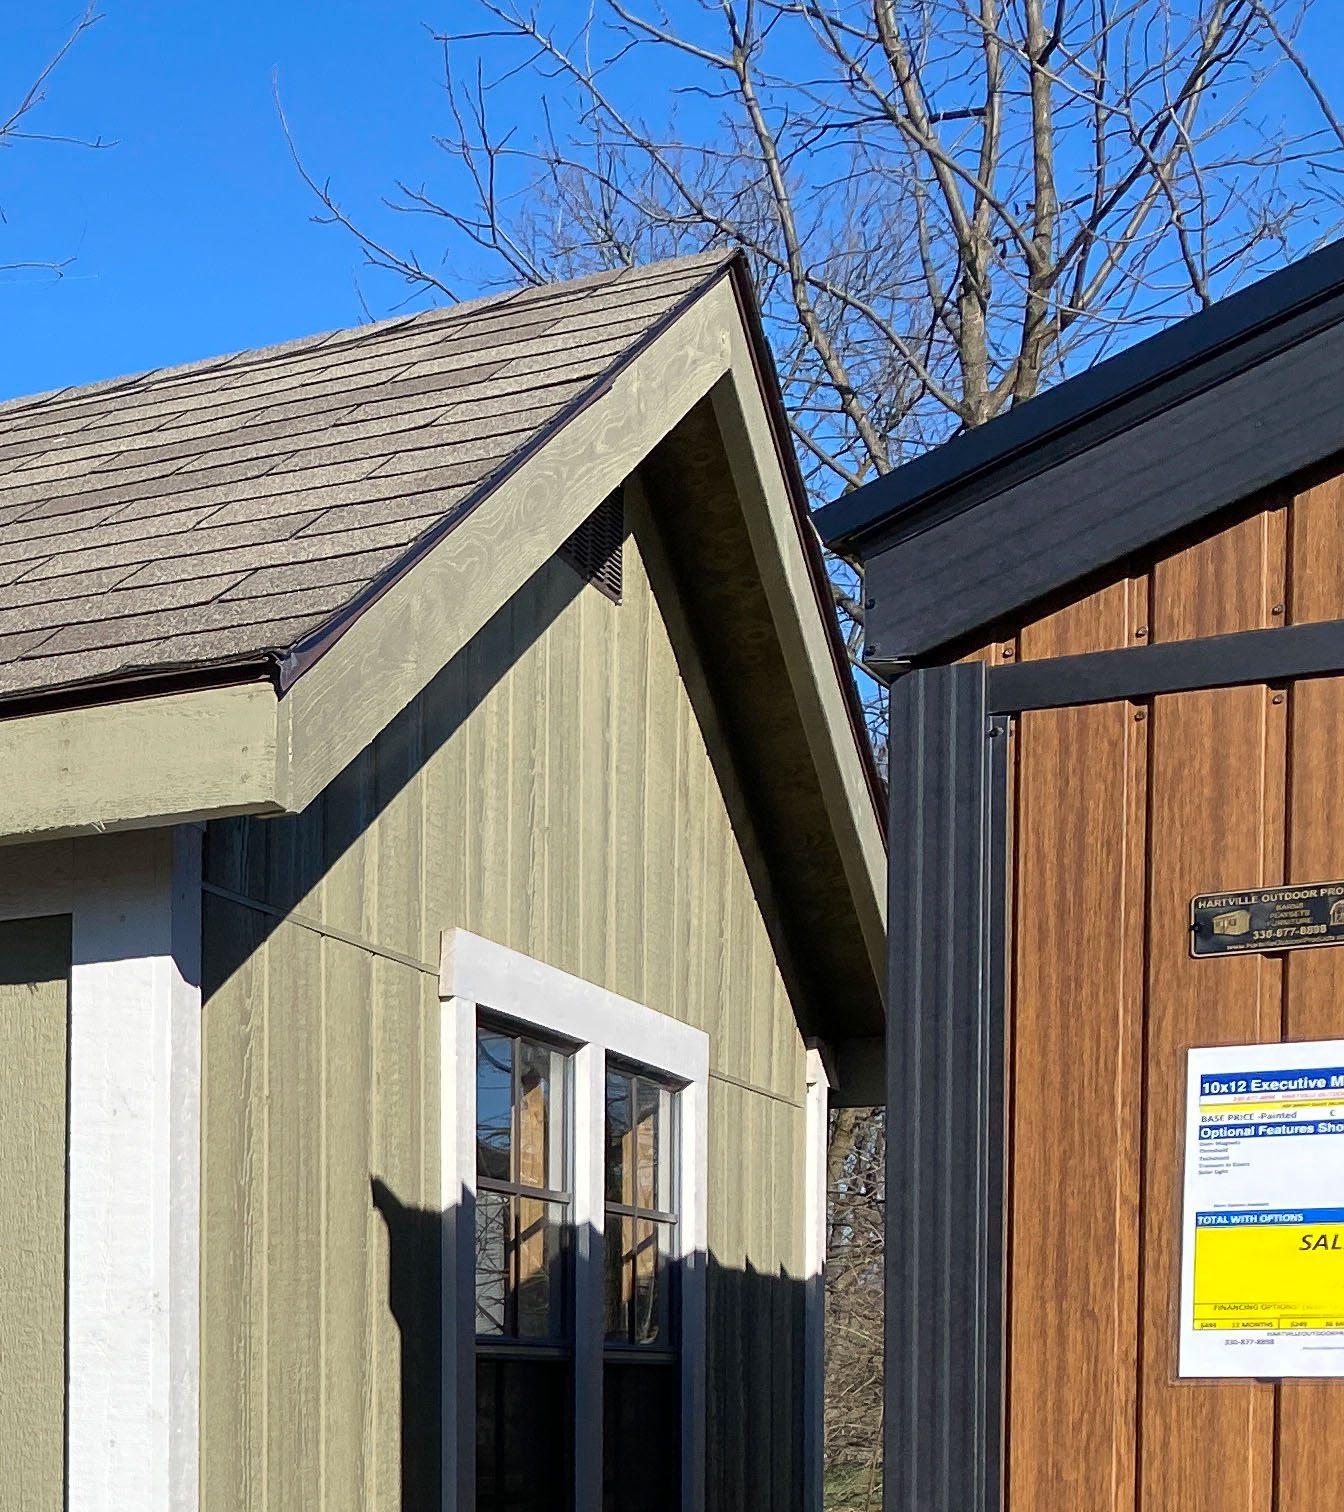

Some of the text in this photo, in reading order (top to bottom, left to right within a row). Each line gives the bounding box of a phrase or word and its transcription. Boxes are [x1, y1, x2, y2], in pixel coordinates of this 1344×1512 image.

[1198, 896, 1259, 909] HARTVILLE
[1261, 889, 1318, 903] OUTDOOR
[1202, 1080, 1247, 1094] 10x12
[1251, 1076, 1327, 1091] Executive
[1201, 1115, 1225, 1123] BASE
[1228, 1113, 1254, 1121] PRICE
[1200, 1126, 1255, 1139] Optional
[1258, 1124, 1315, 1135] Features
[1197, 1213, 1304, 1225] TOTAL WITH OPTIONS
